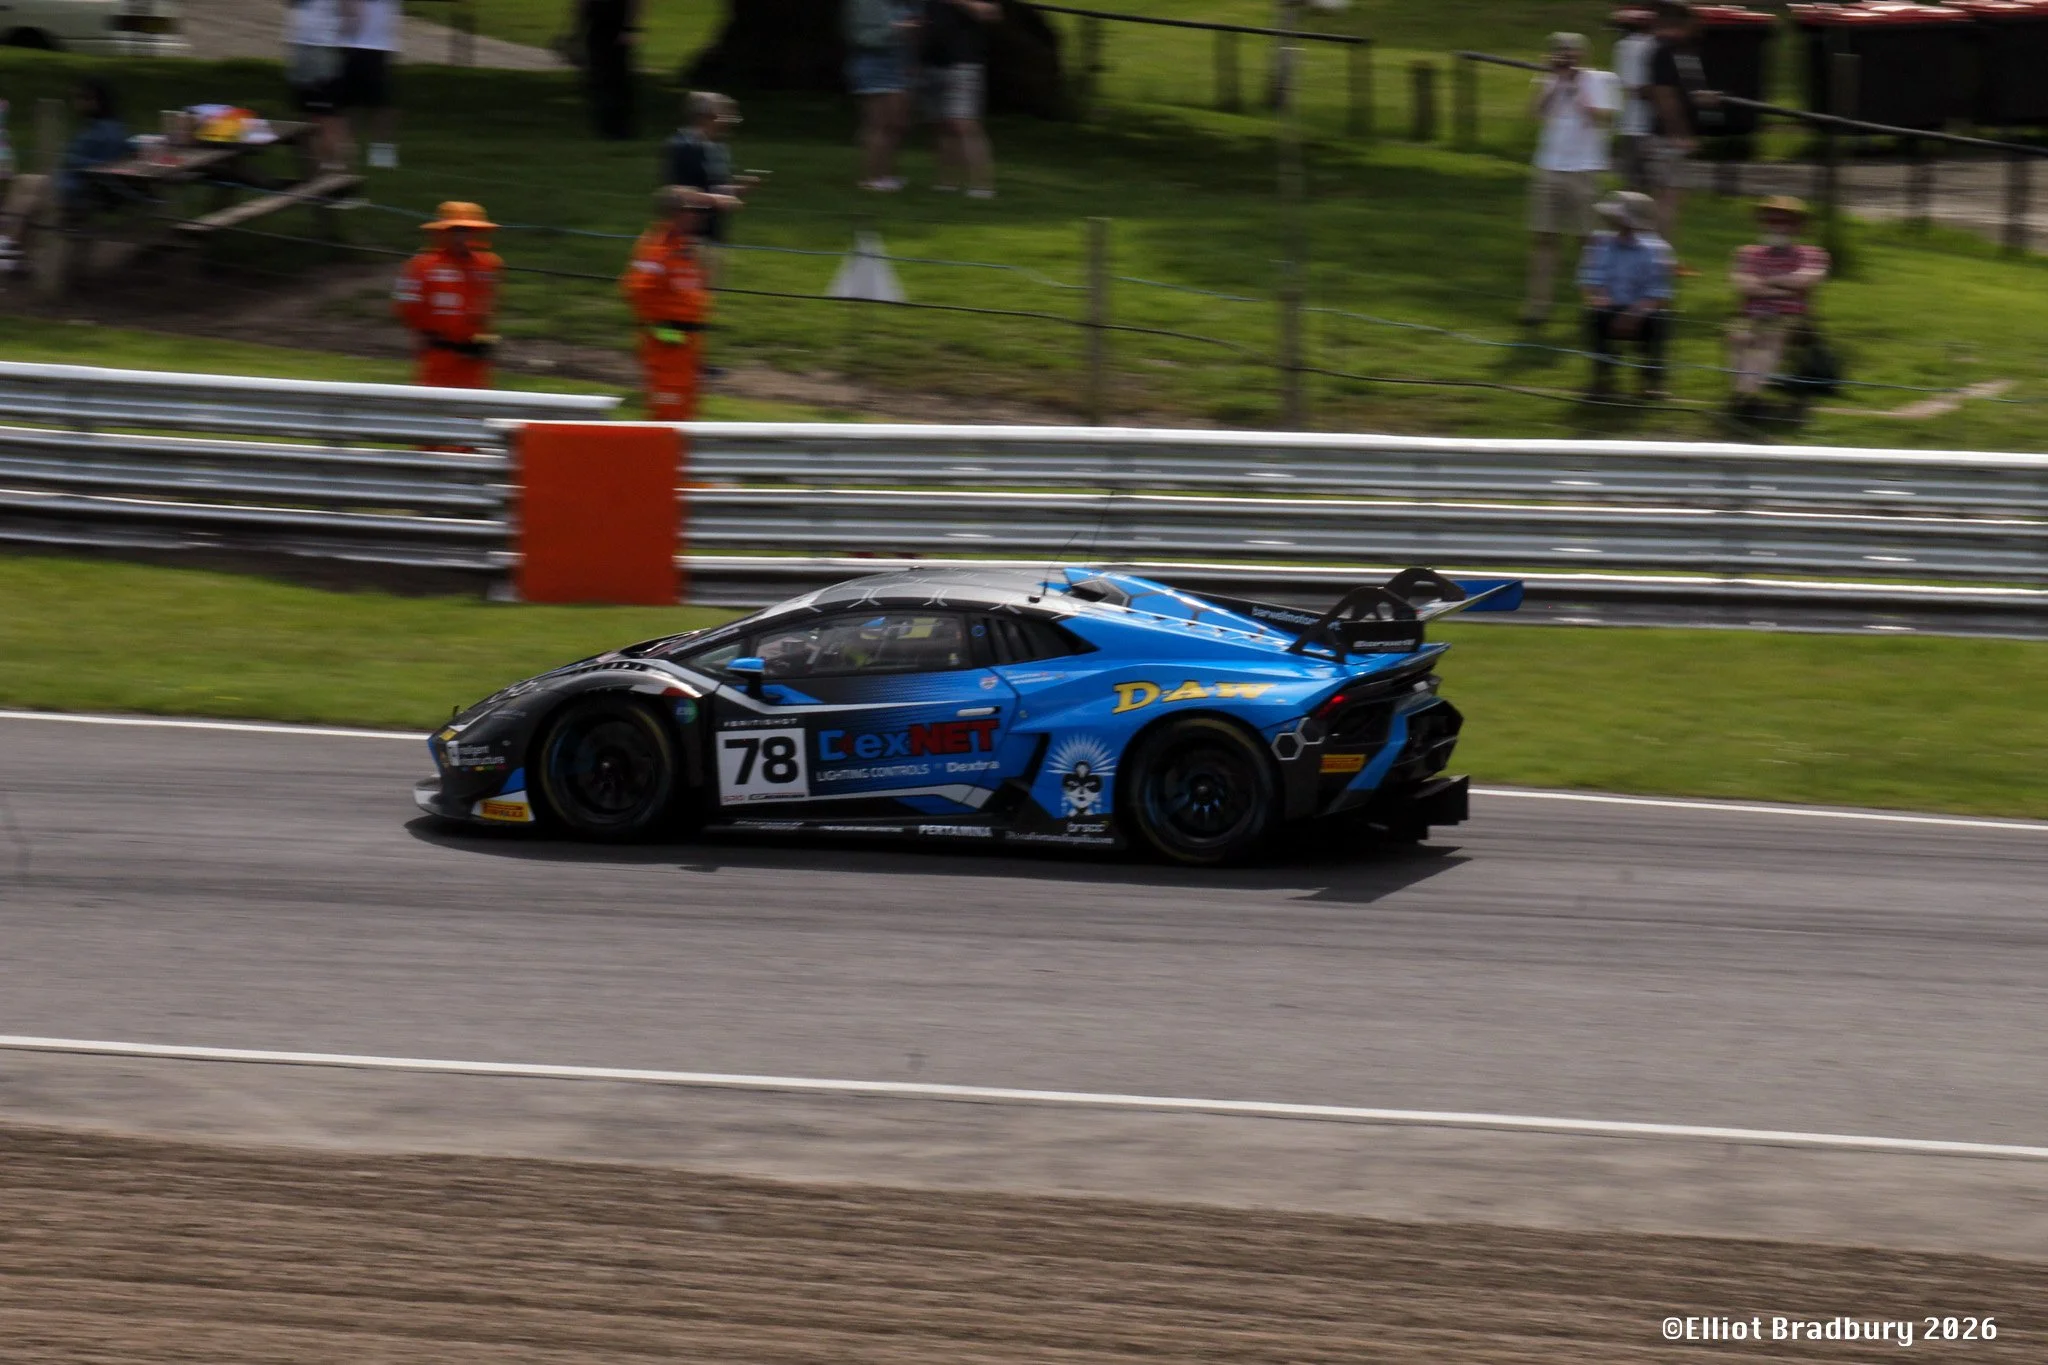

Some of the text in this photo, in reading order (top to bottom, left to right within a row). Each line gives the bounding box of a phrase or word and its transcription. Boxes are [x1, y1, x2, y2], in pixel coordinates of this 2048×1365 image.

[818, 719, 999, 761] DexNET
[724, 736, 798, 785] 78
[815, 764, 930, 782] LIGHTING CONTROLS
[945, 759, 1000, 773] Dextra
